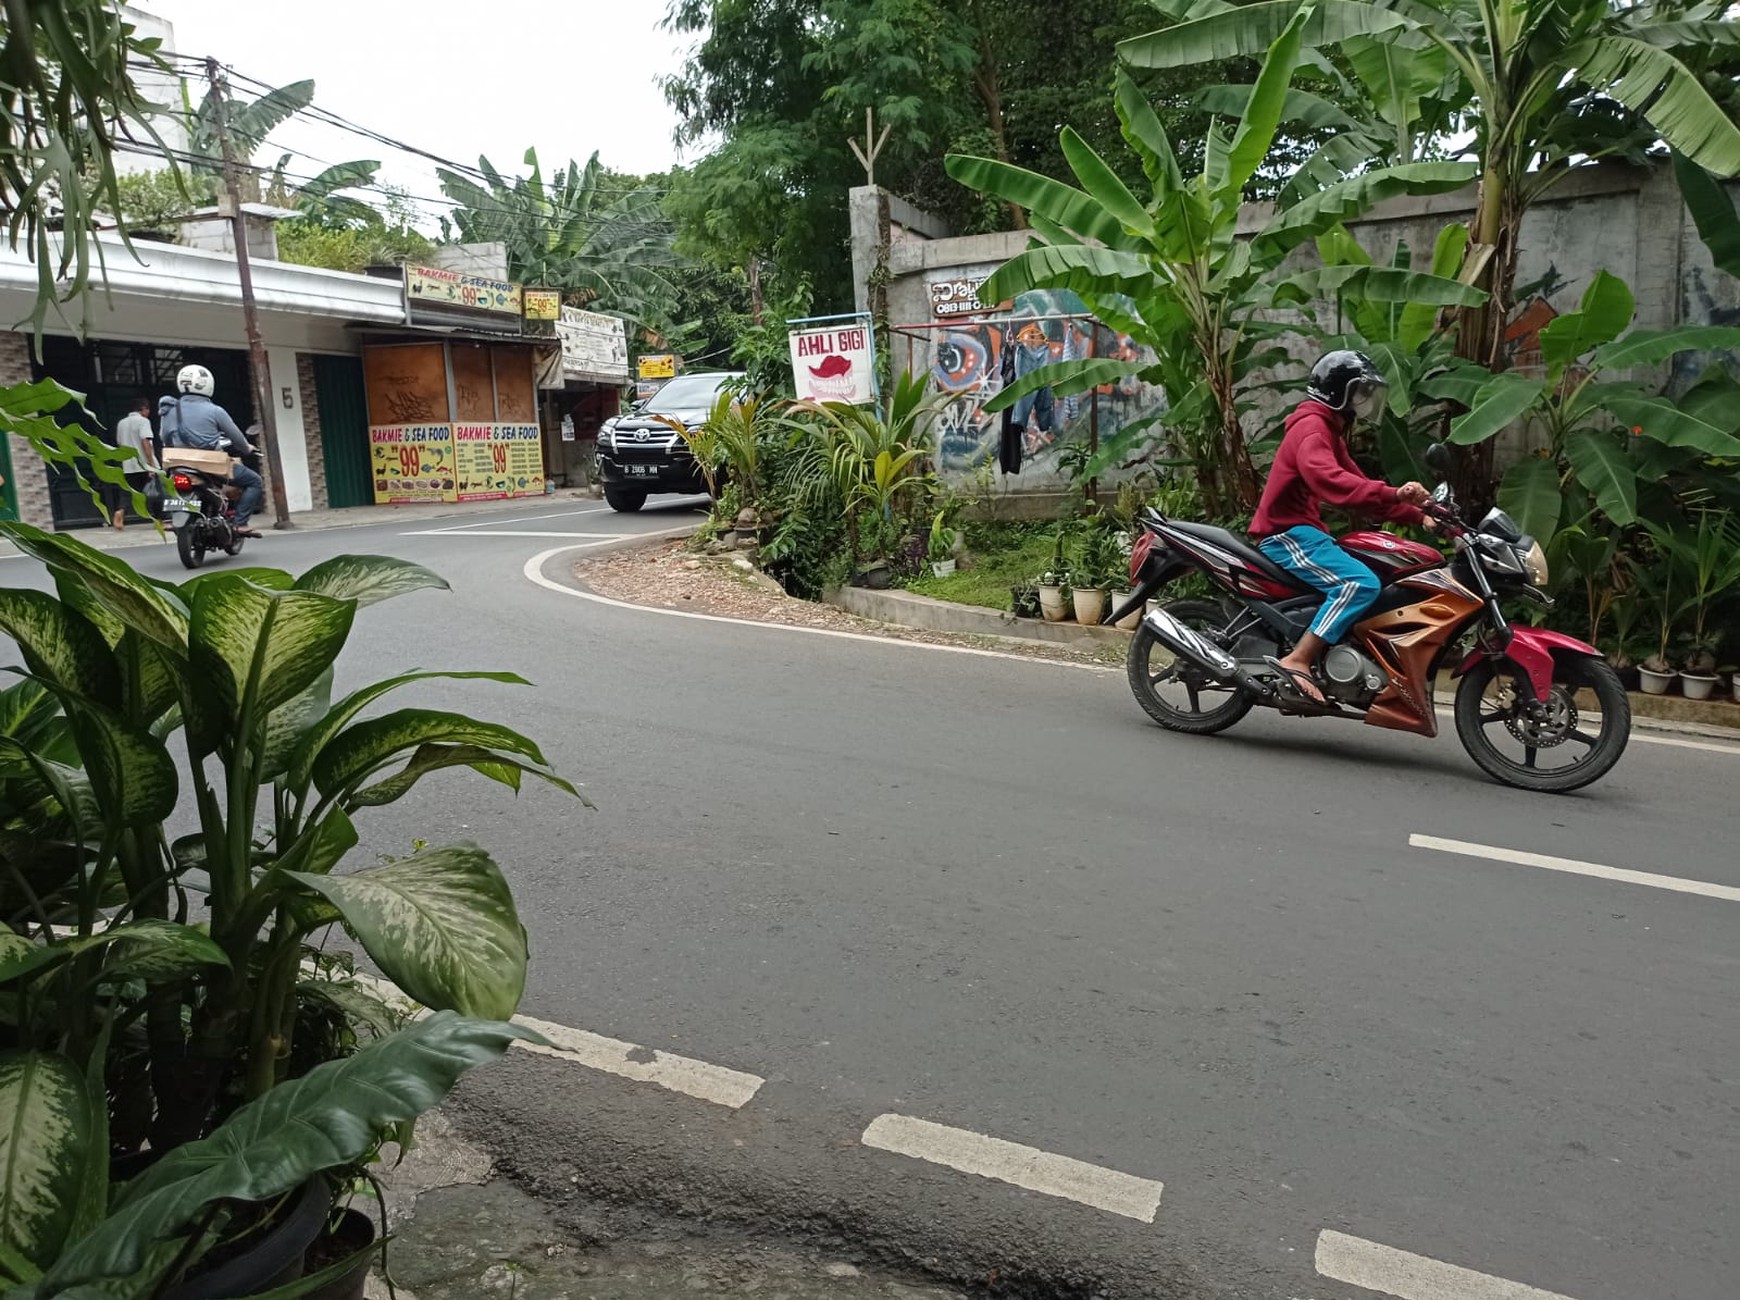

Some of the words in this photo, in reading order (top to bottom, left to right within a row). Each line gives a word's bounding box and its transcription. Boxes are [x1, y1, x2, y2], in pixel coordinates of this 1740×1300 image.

[417, 267, 459, 282] BAKMIE
[469, 278, 488, 288] SEA
[489, 280, 513, 293] FOOD
[798, 334, 833, 357] AHLI
[838, 330, 864, 352] GIGI
[281, 387, 294, 409] 5
[372, 428, 402, 443] BAKMIE
[404, 428, 410, 442] &
[411, 427, 427, 441] SEA
[428, 426, 450, 441] FOOD
[457, 426, 491, 440] BAKMIE
[493, 426, 499, 440] &
[501, 426, 516, 440] SEA
[518, 426, 538, 440] FOOD
[624, 465, 630, 474] B
